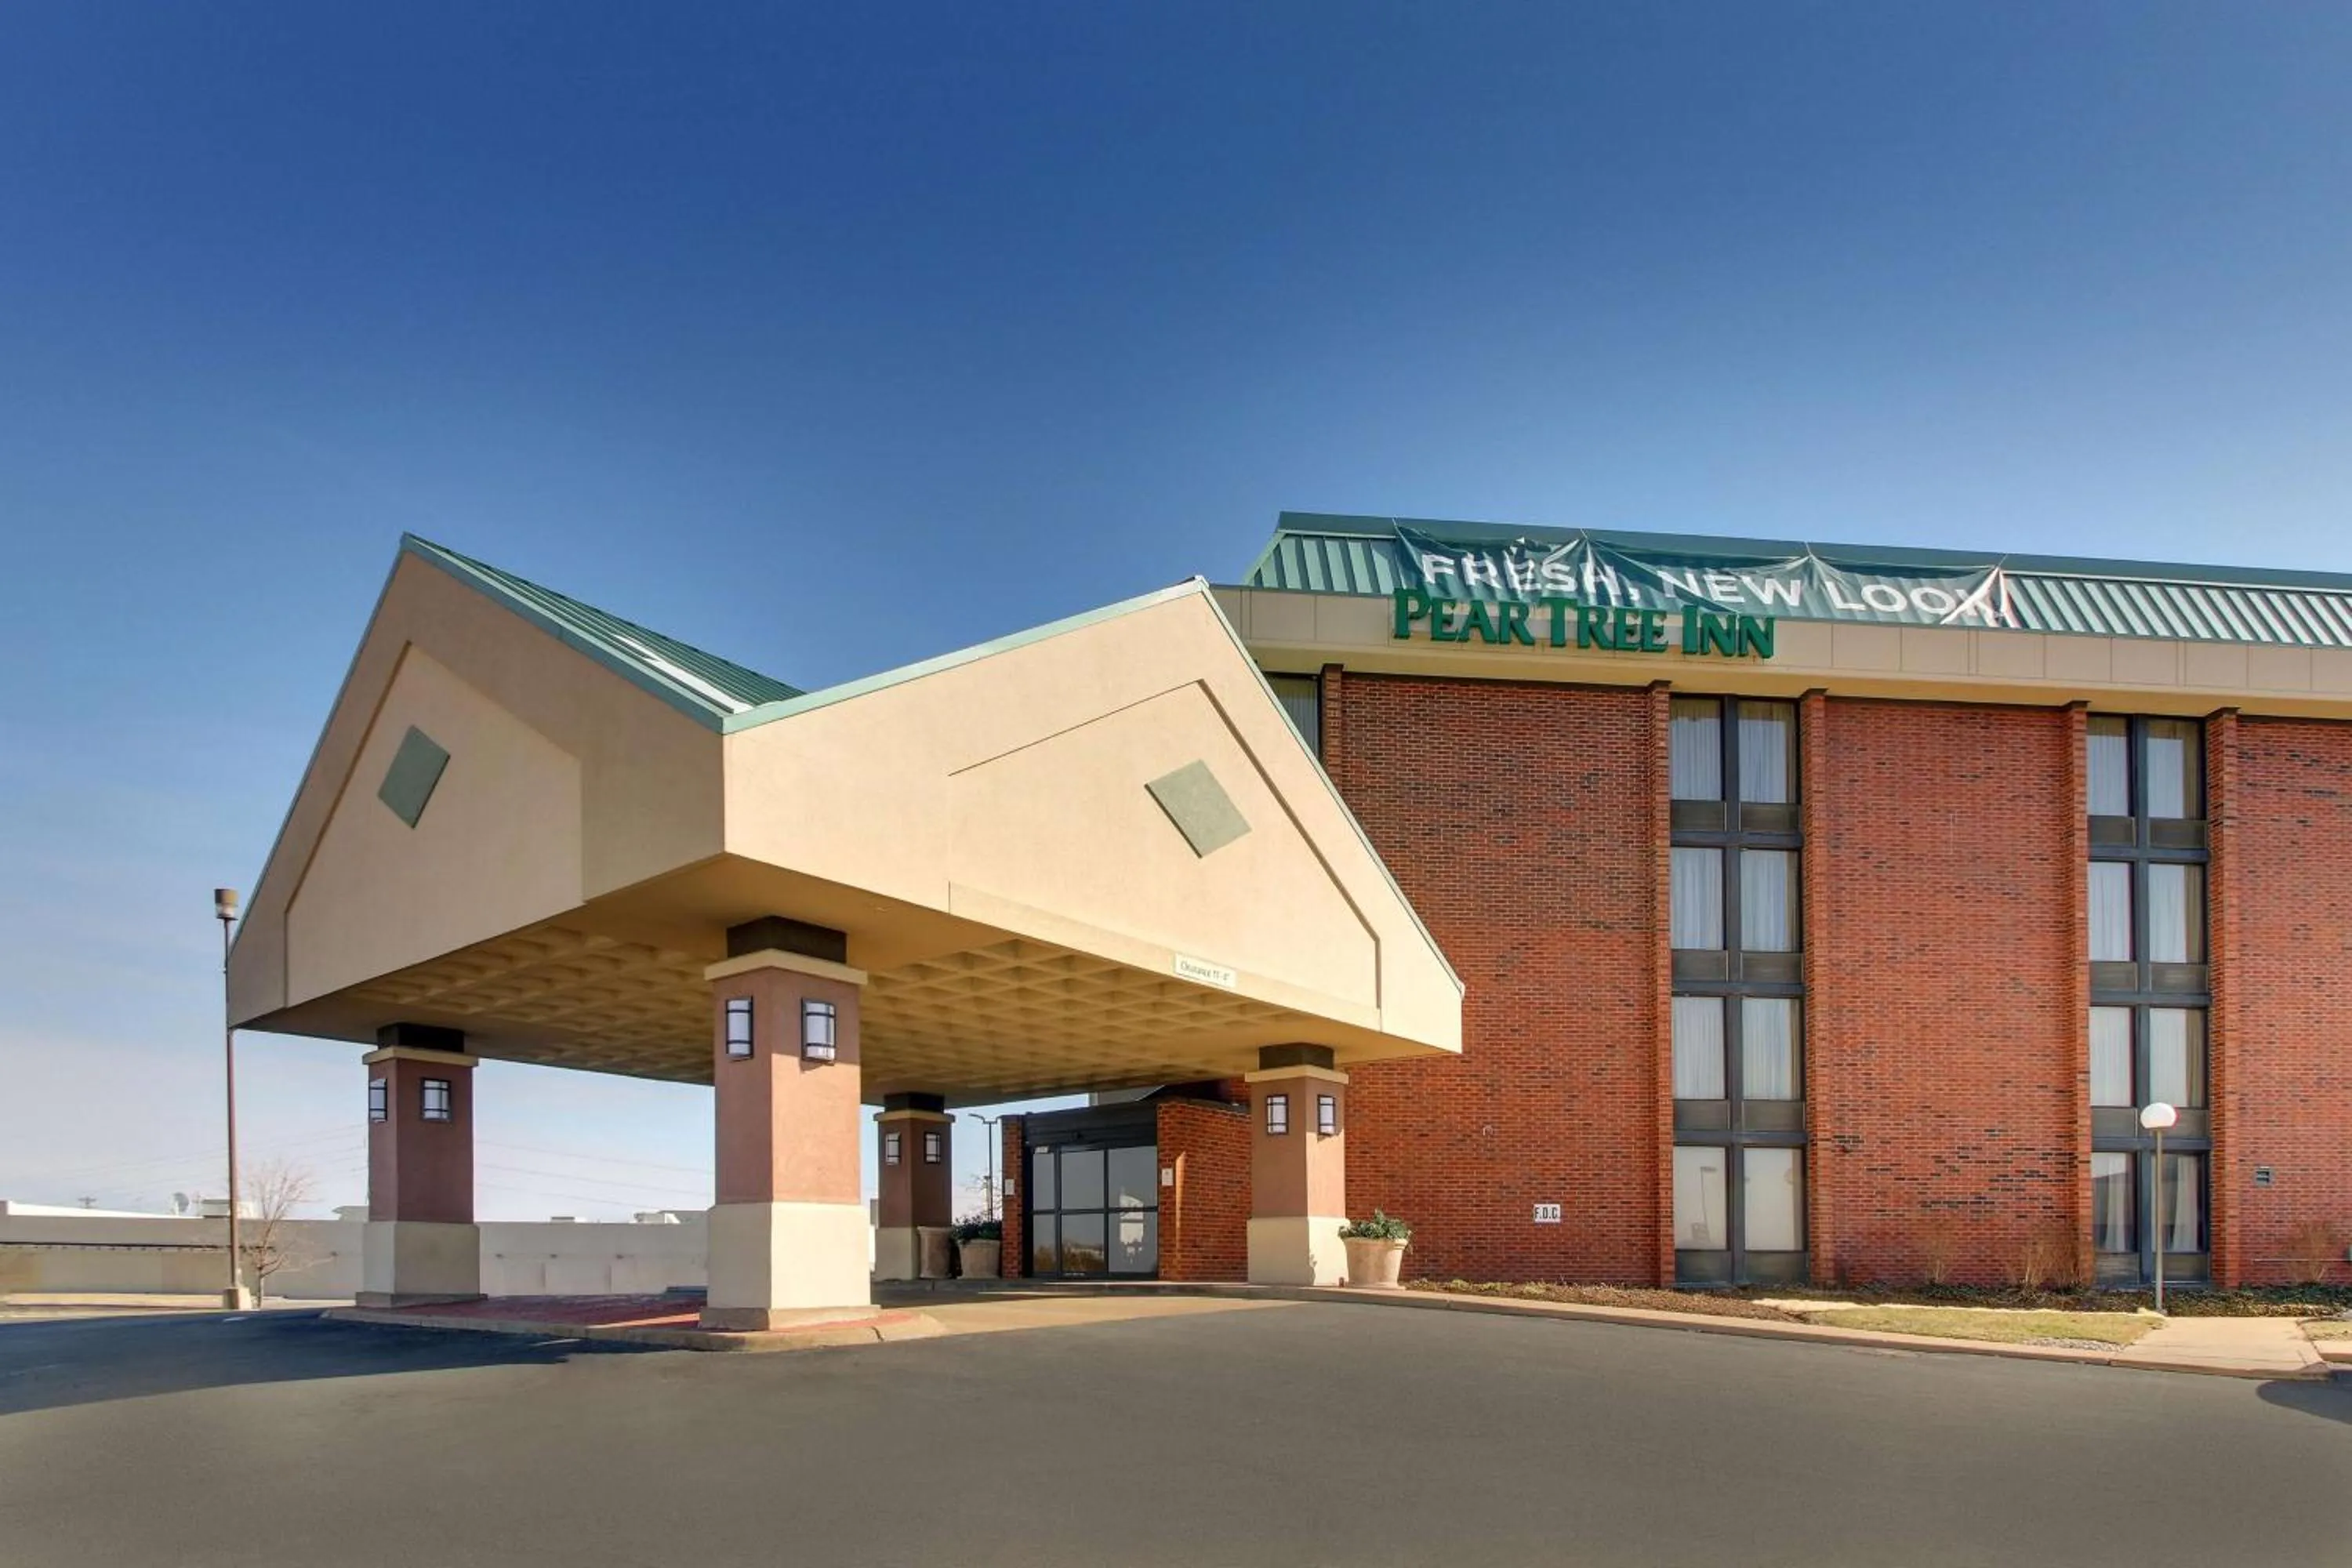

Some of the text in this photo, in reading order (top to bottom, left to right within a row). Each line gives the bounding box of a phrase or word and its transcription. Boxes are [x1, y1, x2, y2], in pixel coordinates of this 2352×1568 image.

[1657, 570, 1801, 607] NEW
[1393, 589, 1773, 659] PEAR TREE INN
